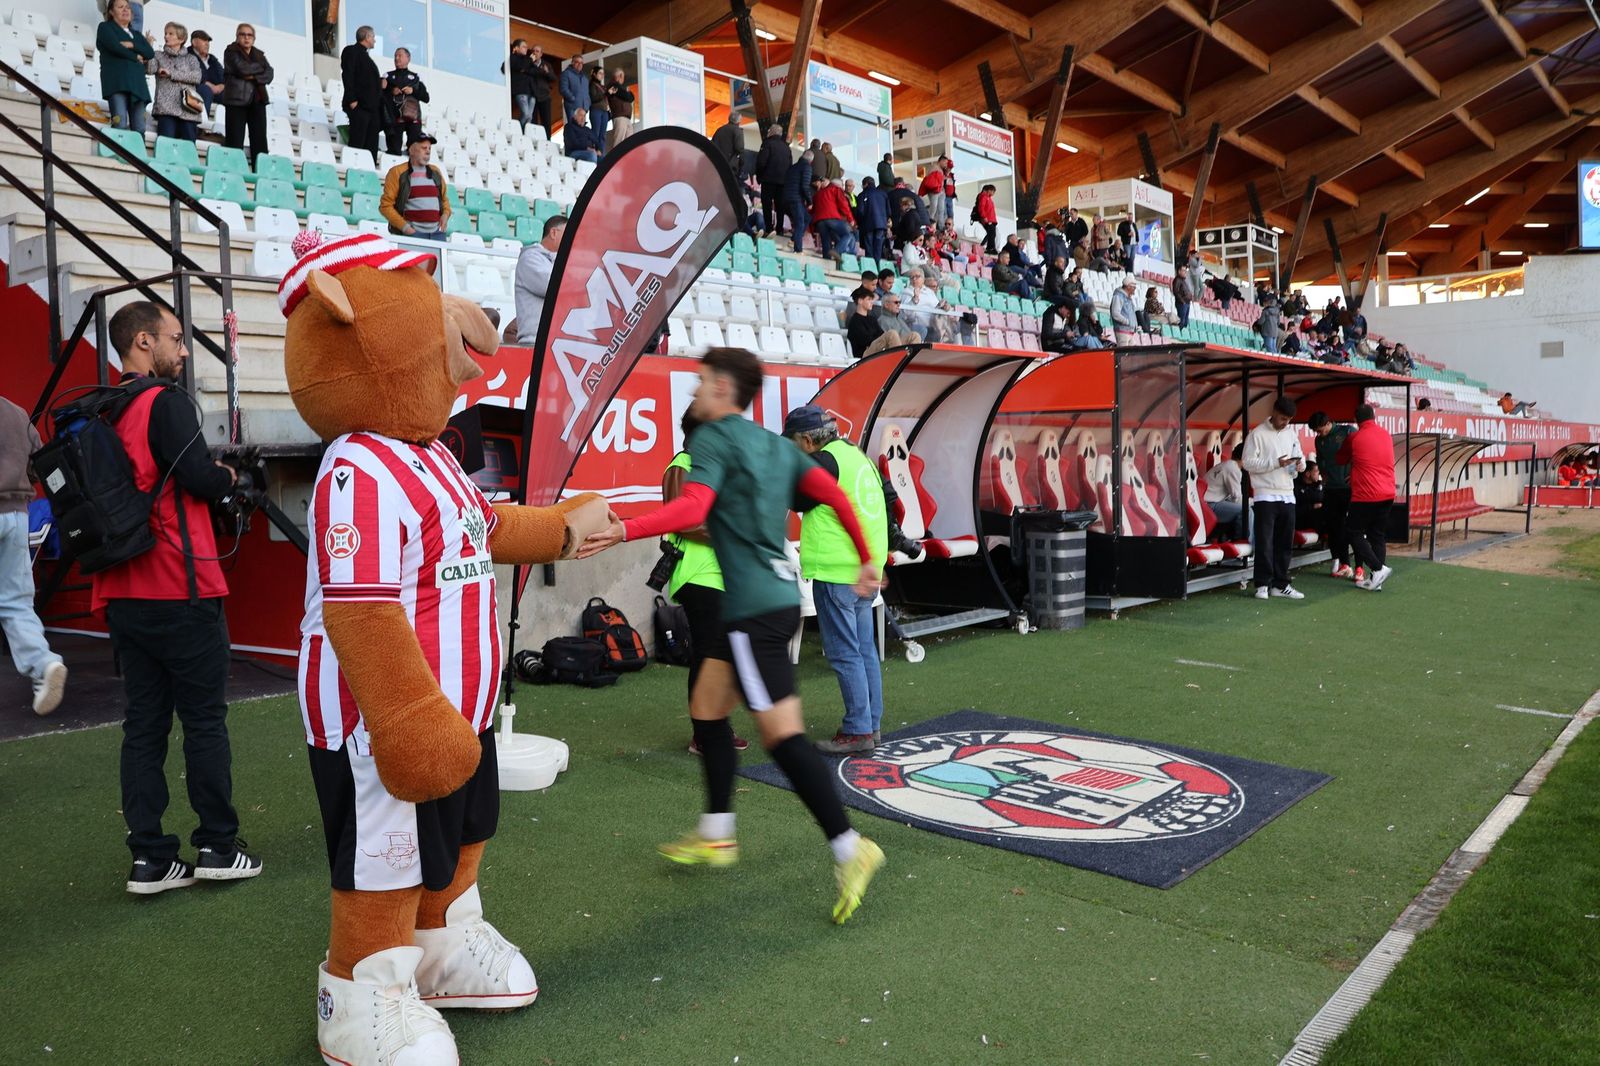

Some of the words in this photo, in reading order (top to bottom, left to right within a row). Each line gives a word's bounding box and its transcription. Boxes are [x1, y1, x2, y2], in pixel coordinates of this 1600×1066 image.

[457, 0, 495, 13] pinión
[551, 180, 719, 442] AMAQ
[584, 277, 663, 394] ALQUILERES
[441, 563, 479, 581] CAJA
